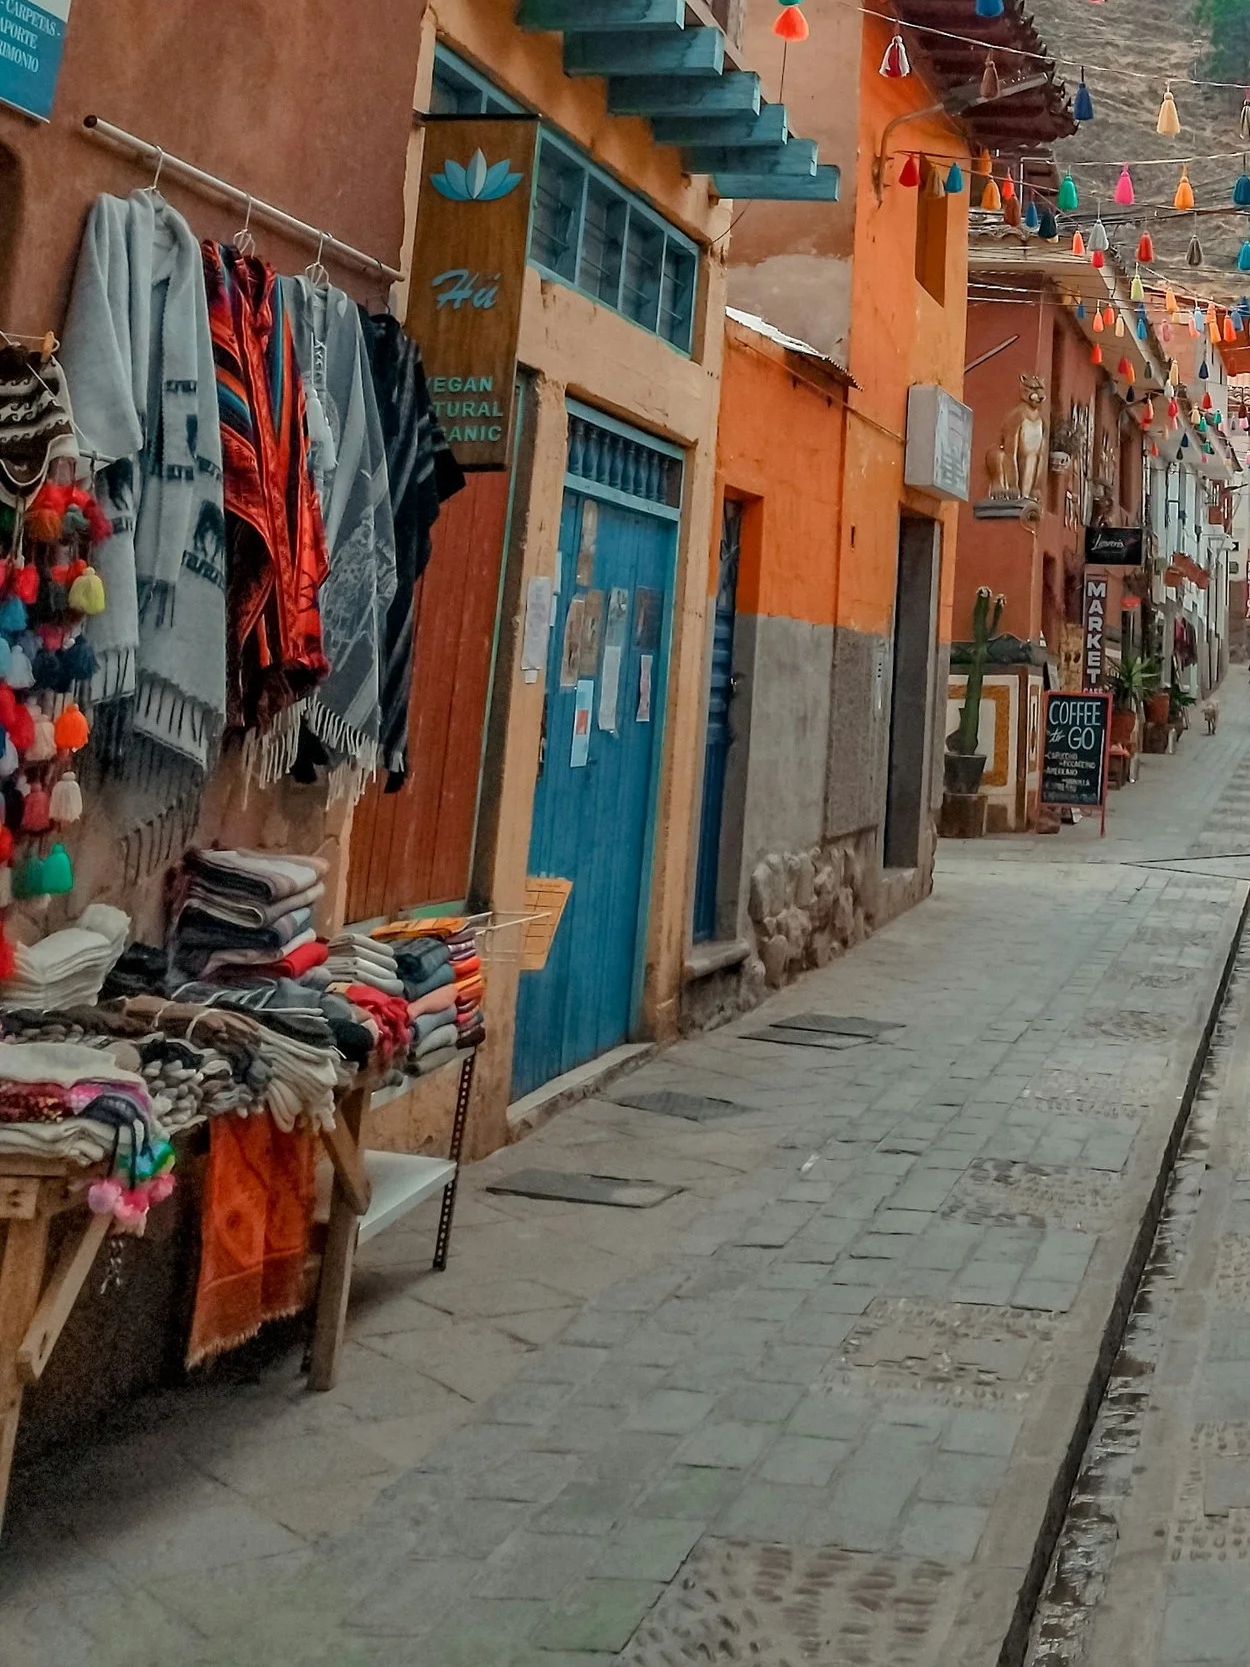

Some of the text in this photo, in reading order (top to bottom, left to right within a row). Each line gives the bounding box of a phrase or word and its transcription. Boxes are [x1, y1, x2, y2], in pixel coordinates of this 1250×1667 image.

[432, 400, 504, 418] TURAL
[445, 425, 503, 442] ANIC
[1086, 581, 1106, 684] MARKET
[1048, 700, 1101, 726] COFFEE
[1067, 726, 1096, 750] GO
